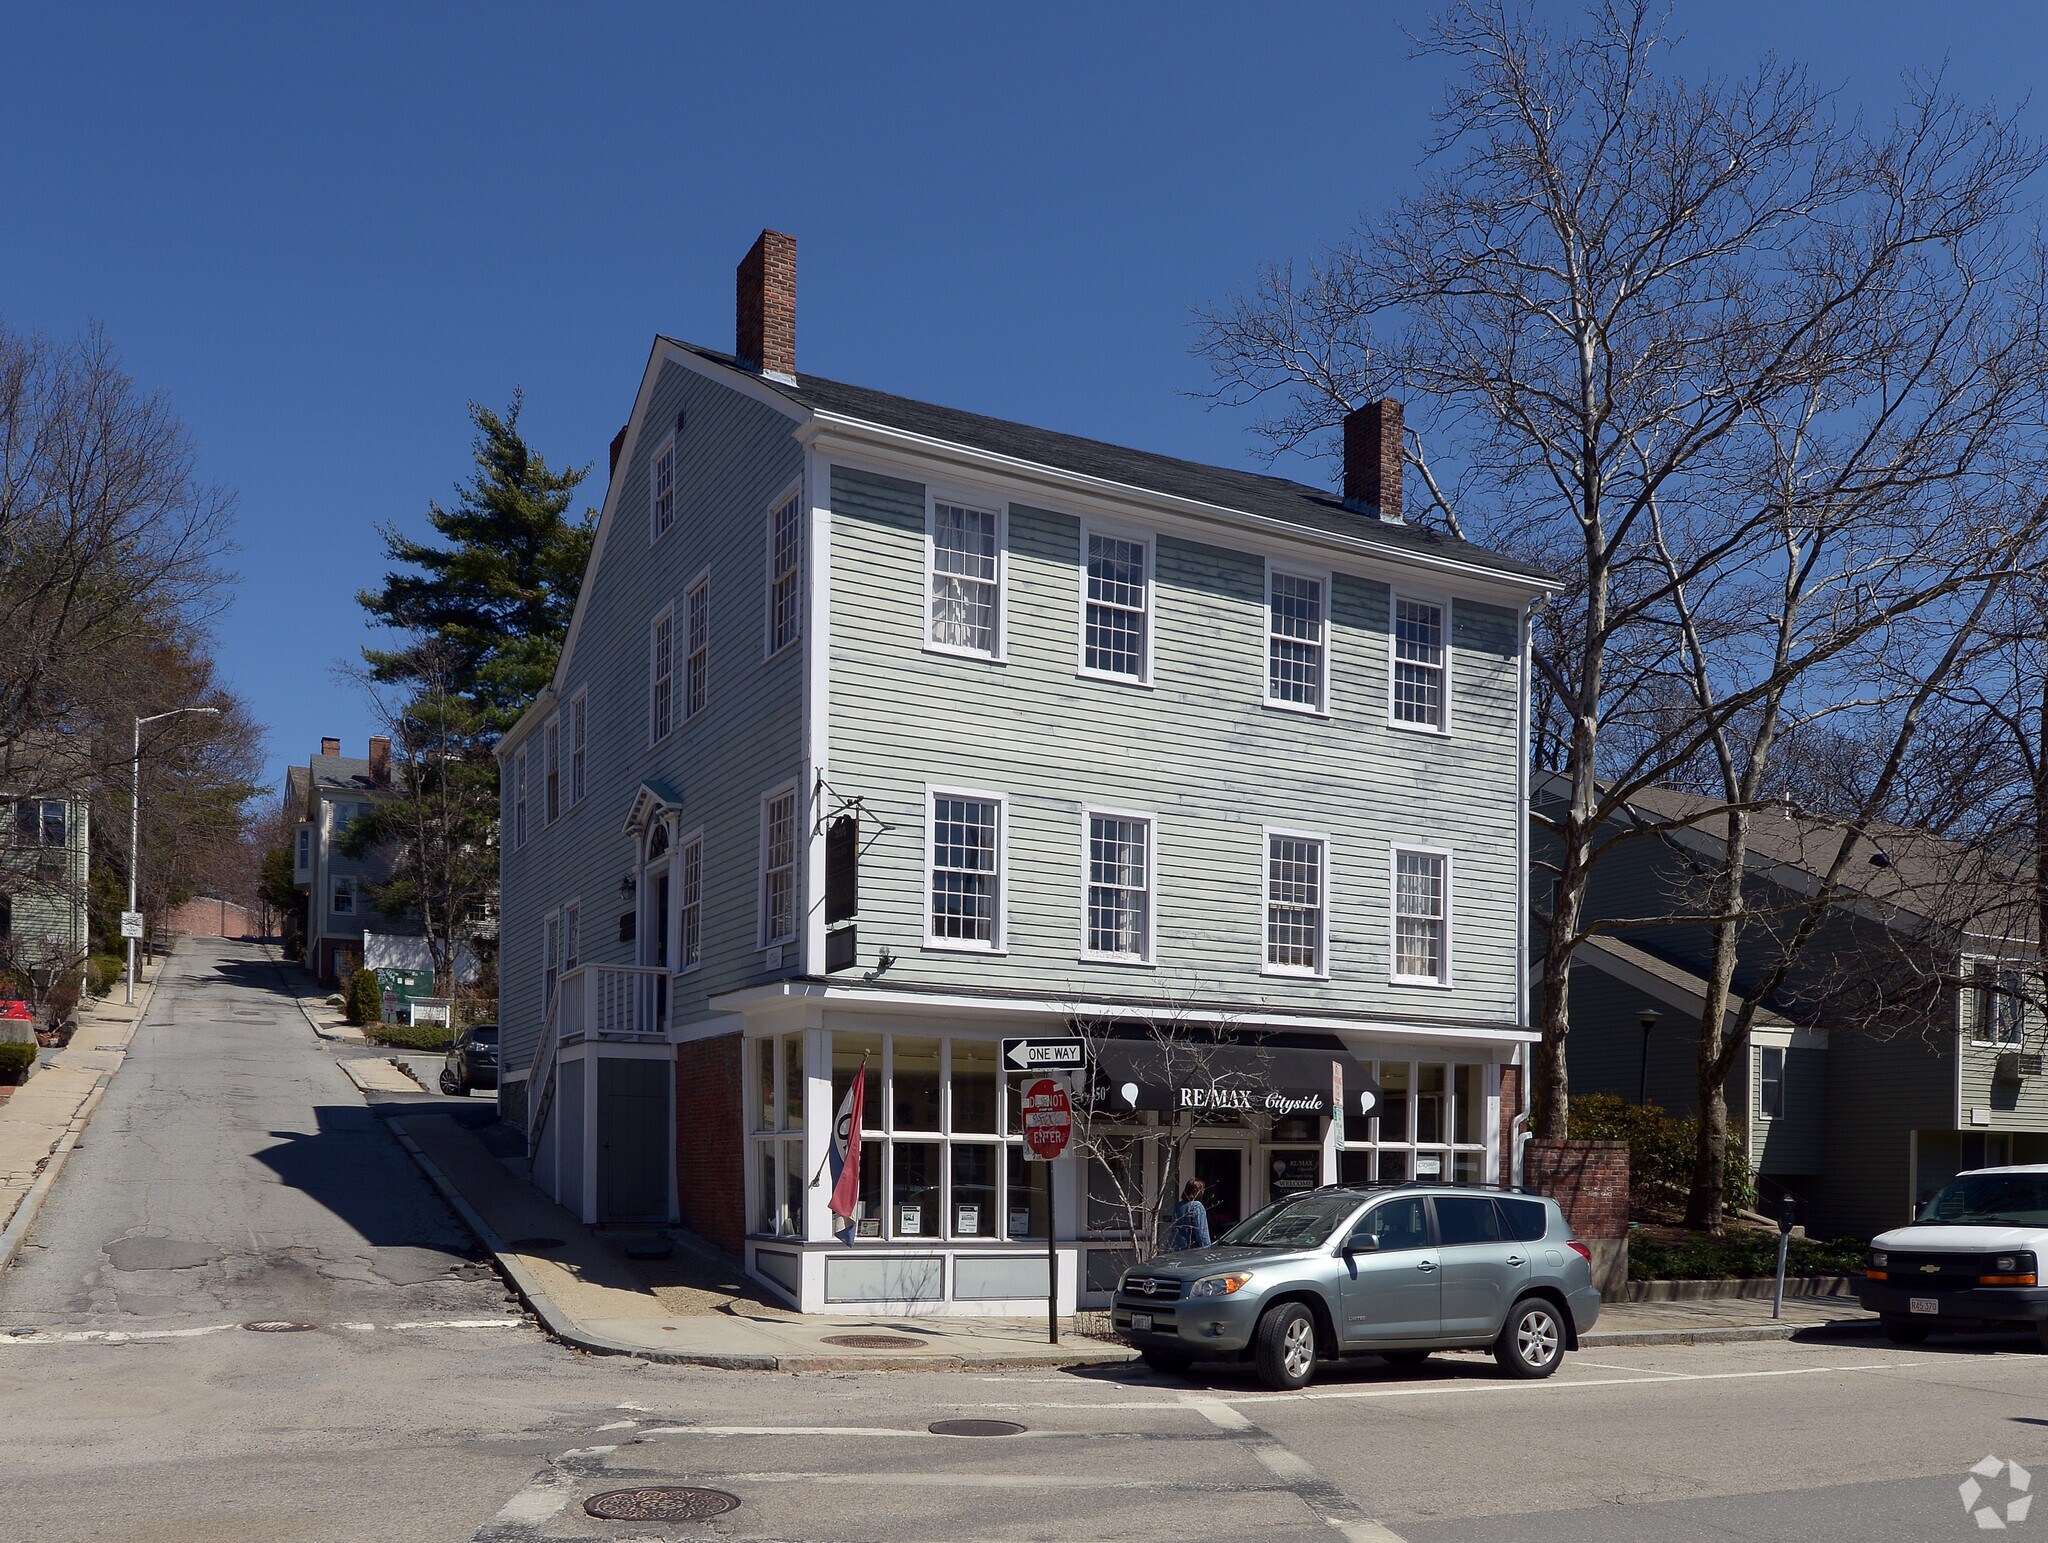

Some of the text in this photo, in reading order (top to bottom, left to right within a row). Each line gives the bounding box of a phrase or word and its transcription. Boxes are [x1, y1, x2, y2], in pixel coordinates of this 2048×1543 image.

[1028, 1047, 1076, 1060] ONE WAY
[1180, 1088, 1324, 1115] RE/MAX Cityside
[1034, 1131, 1061, 1144] ENTER
